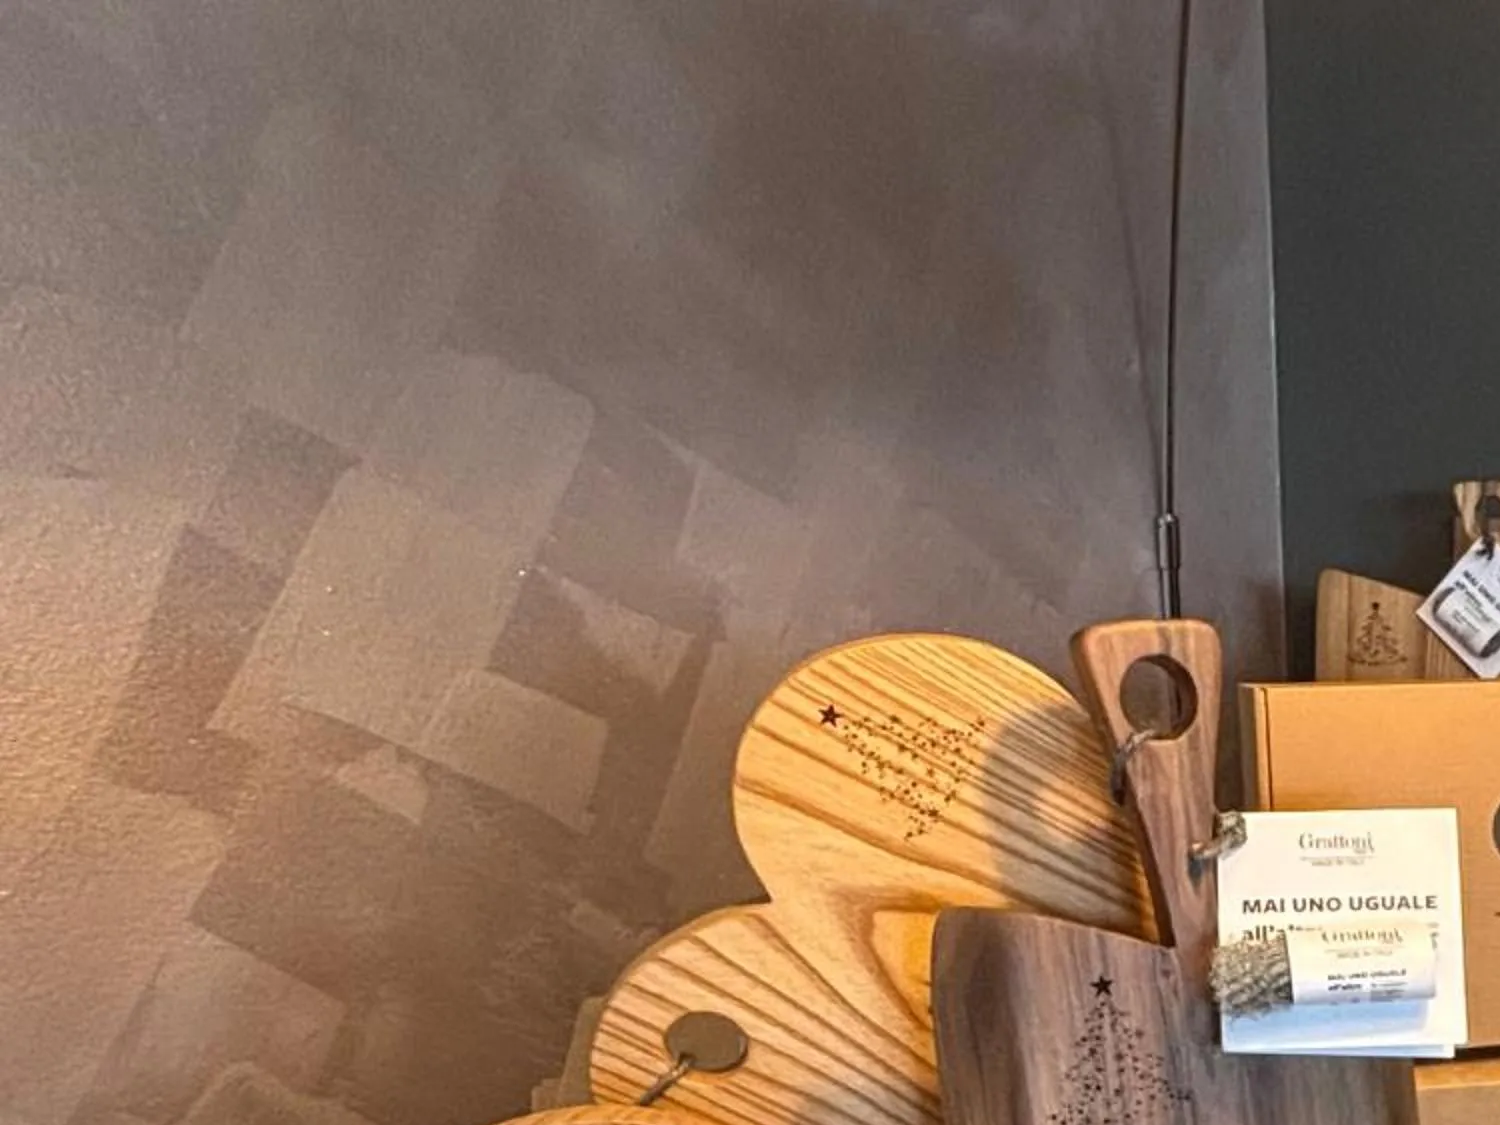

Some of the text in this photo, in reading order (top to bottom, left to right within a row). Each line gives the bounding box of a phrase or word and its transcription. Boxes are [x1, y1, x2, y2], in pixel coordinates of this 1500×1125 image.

[1242, 895, 1439, 915] MAI UNO UGUALE
